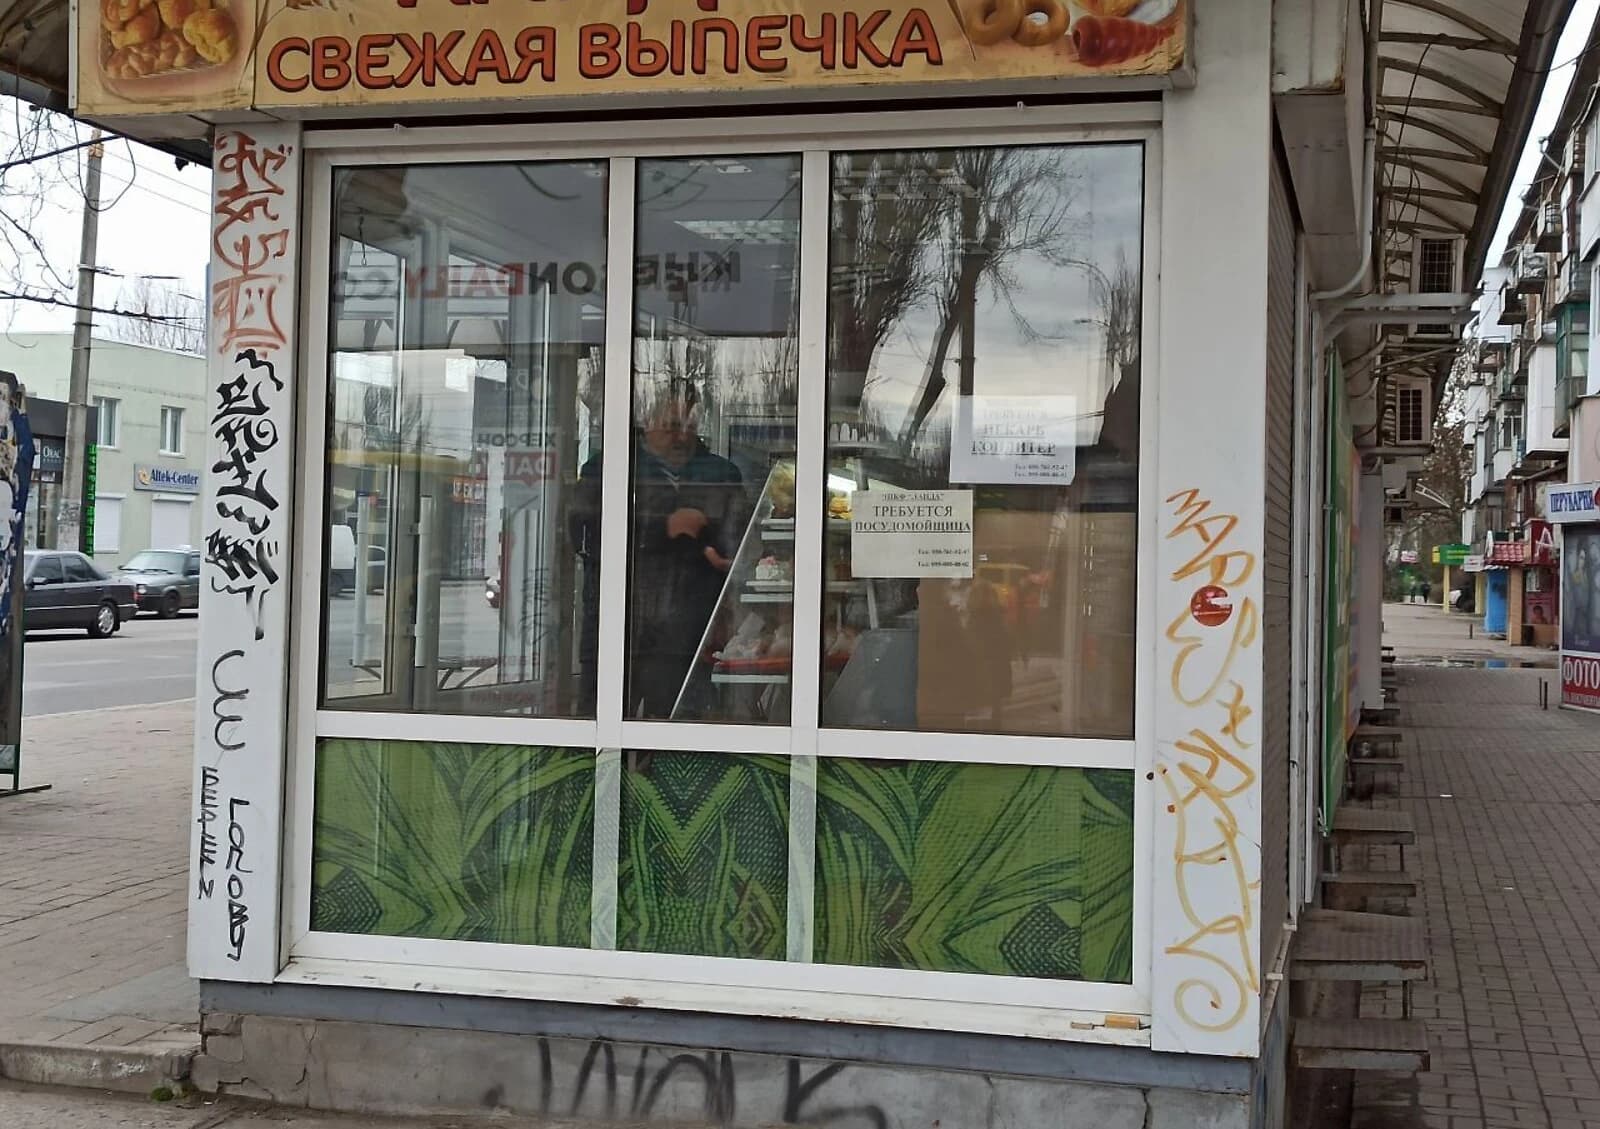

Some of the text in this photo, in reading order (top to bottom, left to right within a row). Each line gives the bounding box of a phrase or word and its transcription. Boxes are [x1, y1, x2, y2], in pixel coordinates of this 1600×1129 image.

[266, 8, 943, 93] СВЕЖАЯ ВЫПЕЧКА
[150, 468, 199, 485] Altek-Center
[873, 505, 953, 518] ТРЕБУЕТСЯ
[855, 520, 971, 533] ПОСУДОМОЙЩИЦА
[1563, 656, 1600, 690] ФОТО
